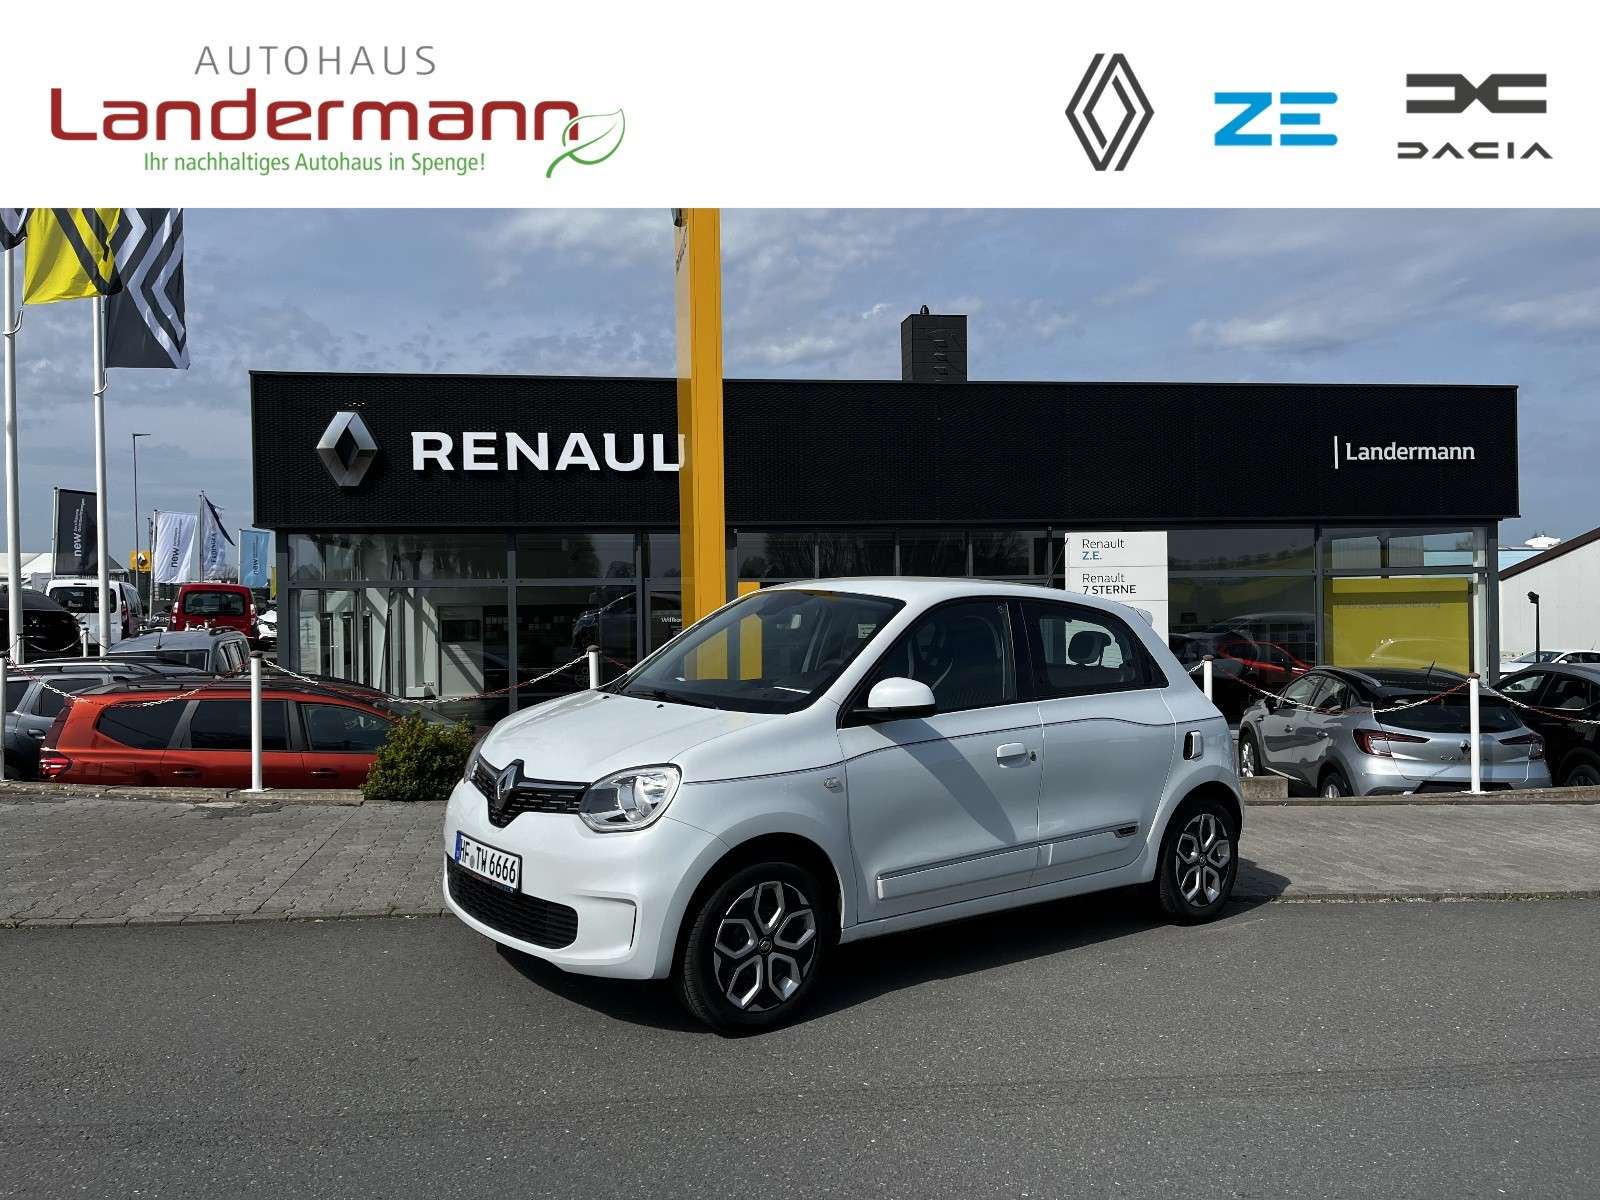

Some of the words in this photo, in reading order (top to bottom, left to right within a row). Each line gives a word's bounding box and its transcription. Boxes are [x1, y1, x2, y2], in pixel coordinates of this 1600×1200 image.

[411, 431, 680, 472] RENAUL
[1346, 441, 1475, 460] Landermann
[1082, 538, 1125, 549] Renault
[1081, 551, 1102, 561] Z.E.
[1082, 573, 1125, 583] Renault
[1082, 586, 1089, 595] 7
[1091, 585, 1137, 595] STERNE
[489, 852, 516, 883] 6666
